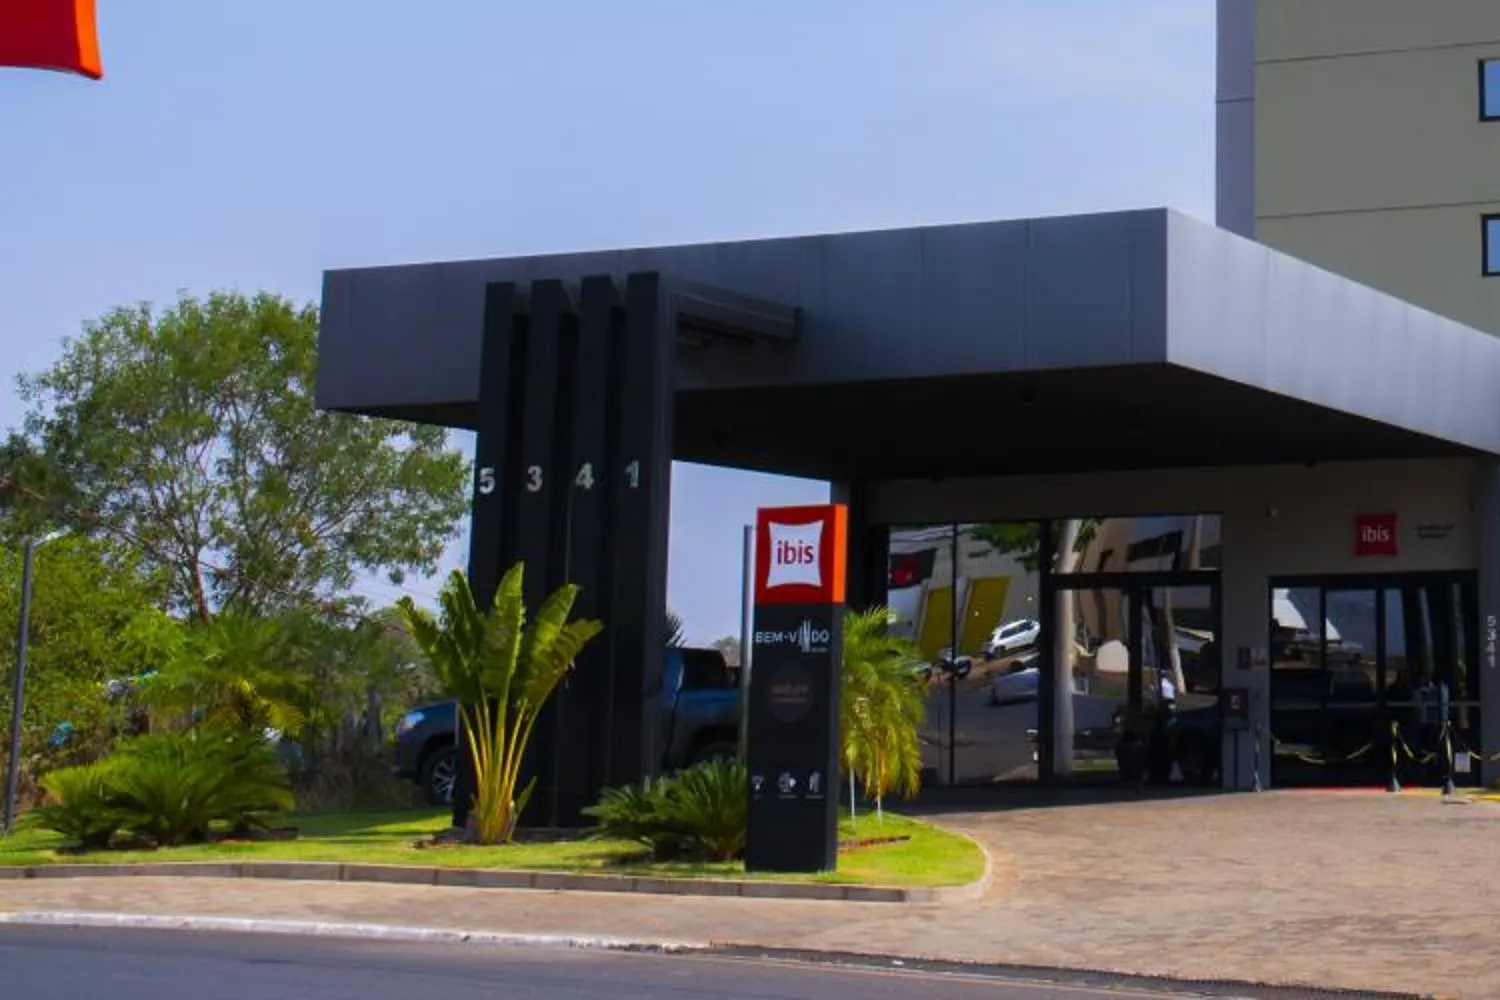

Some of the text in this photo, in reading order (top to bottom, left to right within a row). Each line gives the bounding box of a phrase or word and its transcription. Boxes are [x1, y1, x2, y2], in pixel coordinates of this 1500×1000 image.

[479, 460, 639, 494] 5 3 4 1
[777, 540, 814, 565] ibis
